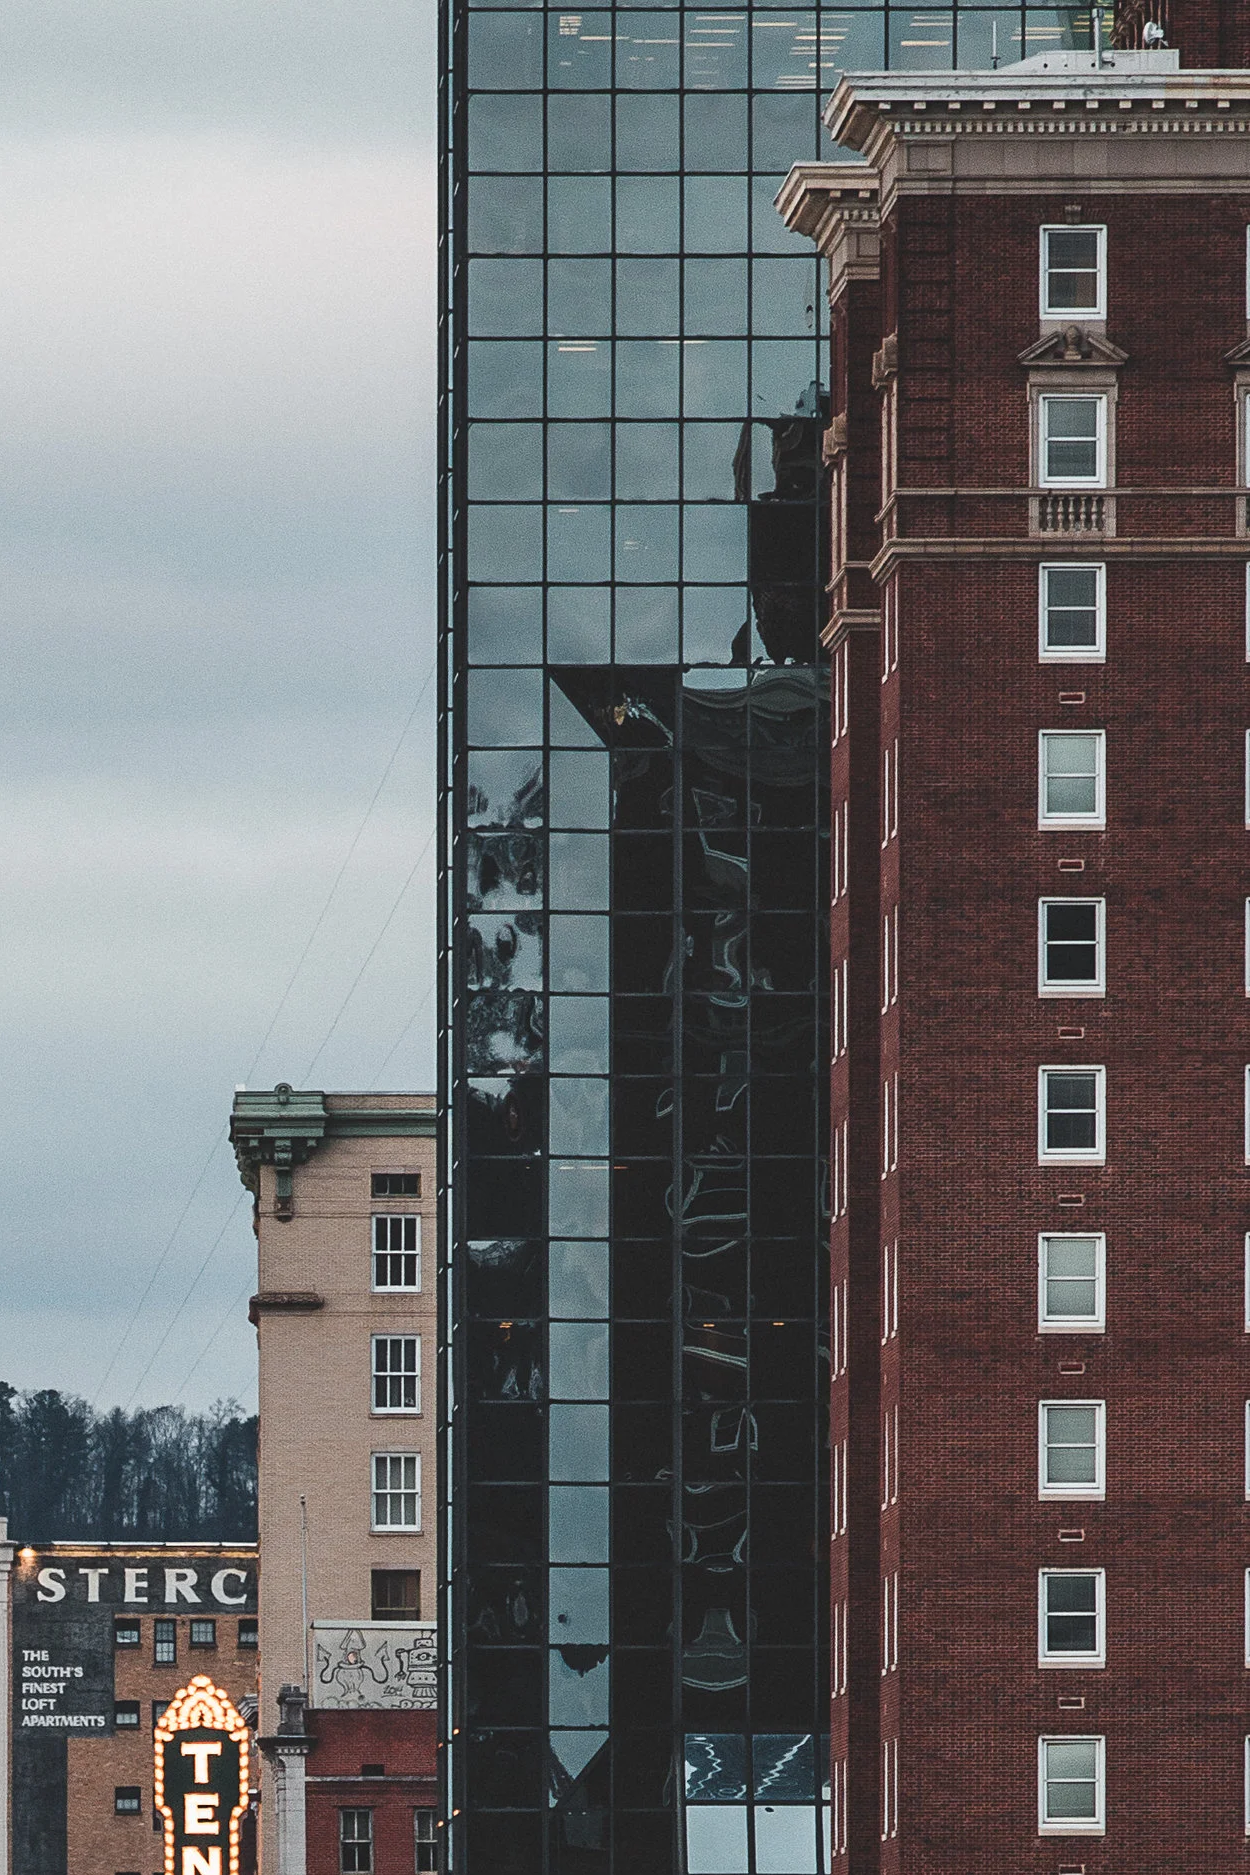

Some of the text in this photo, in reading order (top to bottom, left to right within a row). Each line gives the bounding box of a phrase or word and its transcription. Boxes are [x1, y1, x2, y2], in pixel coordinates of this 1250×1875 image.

[36, 1566, 249, 1605] STERC
[21, 1649, 50, 1662] THE
[21, 1665, 83, 1678] SOUTH'S
[21, 1682, 65, 1695] FINEST
[21, 1698, 56, 1711] LOFT
[21, 1714, 106, 1728] APARTMENTS
